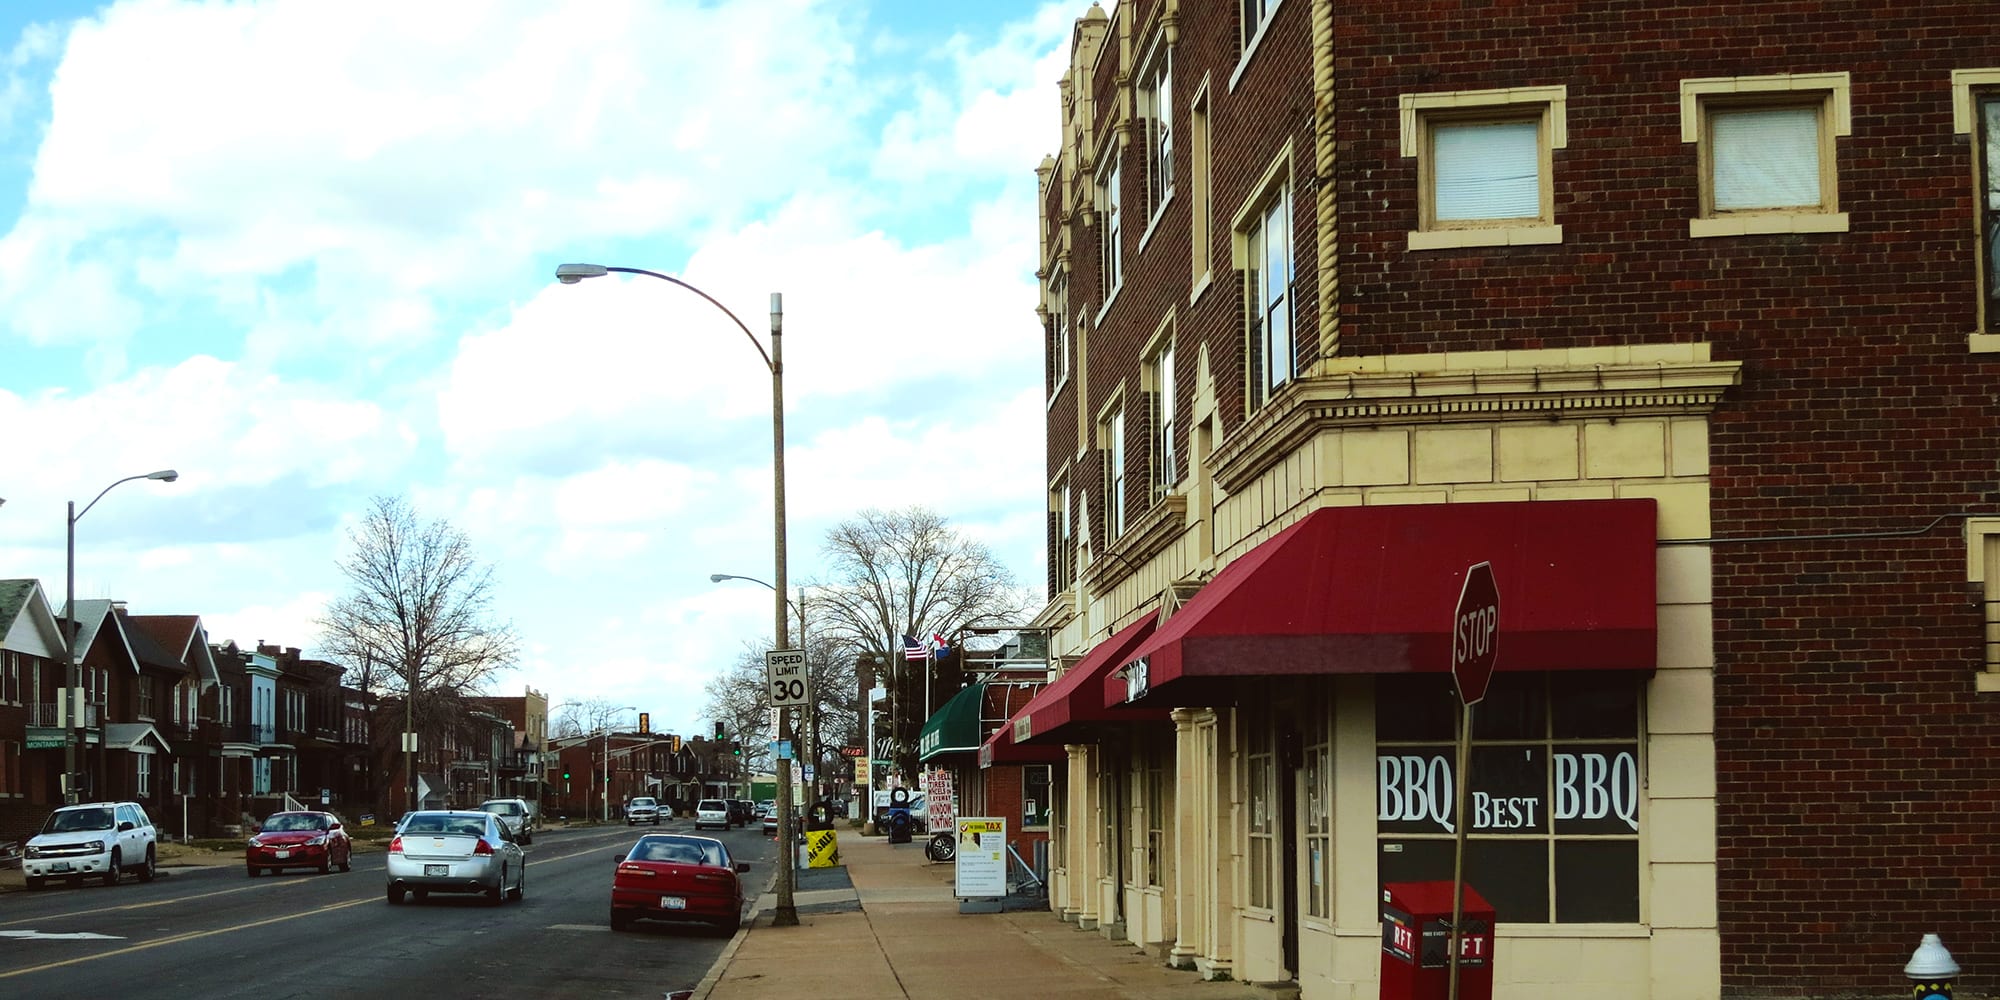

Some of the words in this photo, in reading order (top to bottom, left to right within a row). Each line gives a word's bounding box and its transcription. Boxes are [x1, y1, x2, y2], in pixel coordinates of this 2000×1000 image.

[1458, 605, 1496, 663] STOP
[771, 655, 803, 665] SPEED
[775, 666, 800, 676] LIMIT
[773, 679, 805, 701] 30
[26, 741, 58, 749] MONTANA
[1377, 755, 1455, 833] BBQ
[1553, 751, 1640, 832] BBQ
[929, 803, 952, 815] WINDOW
[930, 817, 952, 829] TINTING
[985, 822, 1001, 830] TAX
[1394, 926, 1412, 950] RFT
